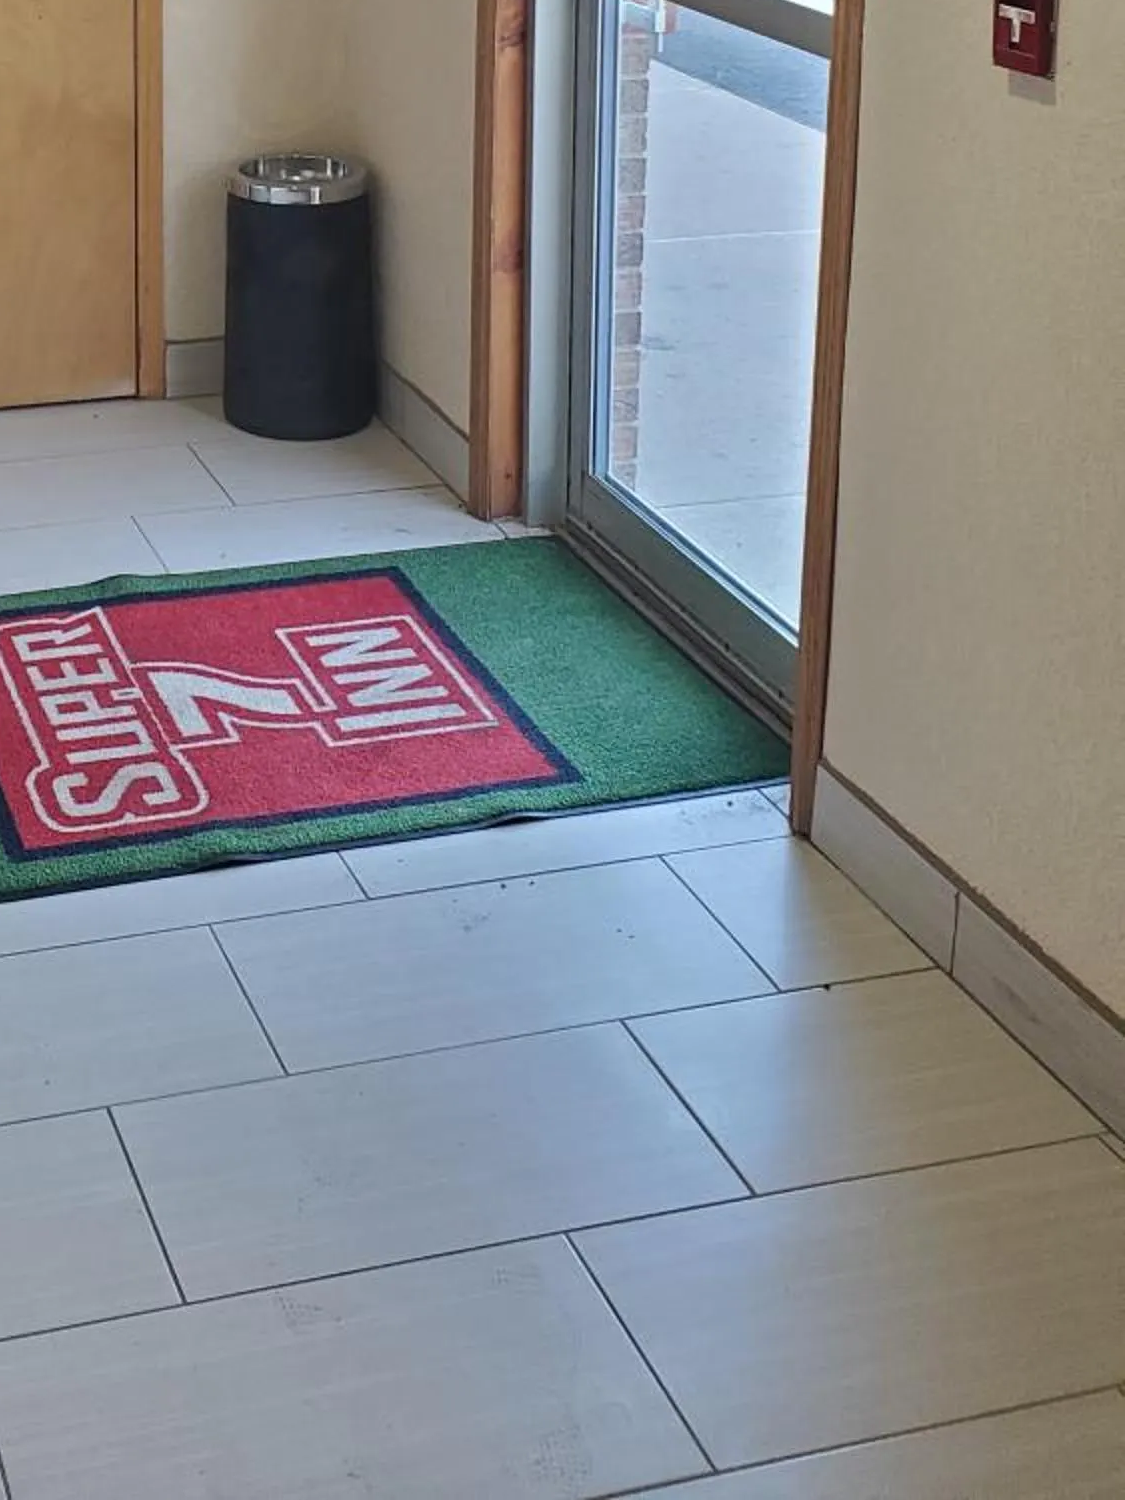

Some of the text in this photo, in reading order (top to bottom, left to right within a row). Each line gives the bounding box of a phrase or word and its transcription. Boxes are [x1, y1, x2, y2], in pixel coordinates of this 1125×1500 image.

[10, 620, 182, 819] SUPER
[145, 669, 294, 737] 7
[305, 625, 467, 733] INN
